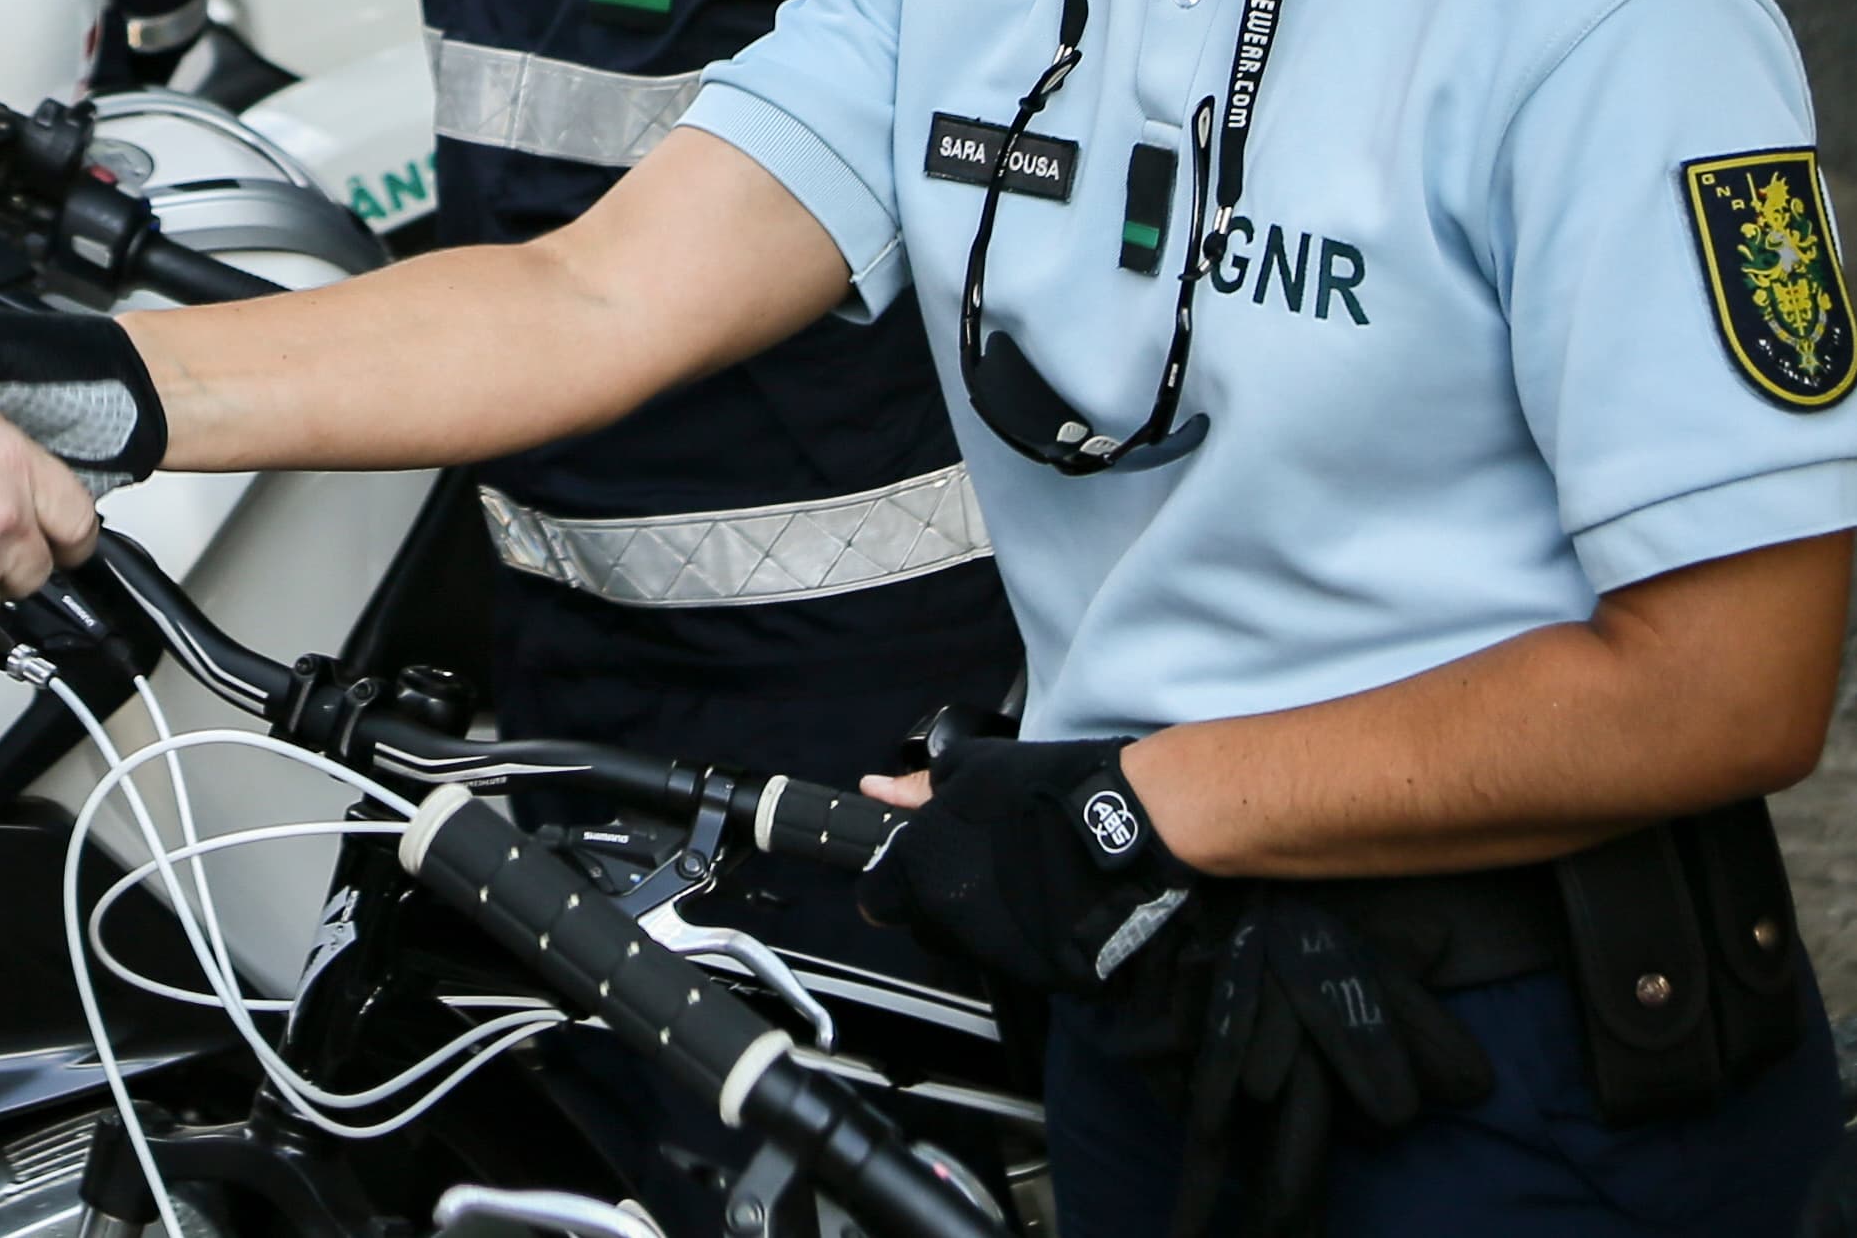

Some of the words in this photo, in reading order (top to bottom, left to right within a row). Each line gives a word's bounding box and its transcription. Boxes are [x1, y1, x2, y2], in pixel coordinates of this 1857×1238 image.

[939, 136, 986, 164] SARA
[996, 148, 1060, 180] OUSA
[1701, 173, 1746, 211] GNR
[1211, 216, 1370, 325] GNR
[1092, 802, 1131, 846] ABS
